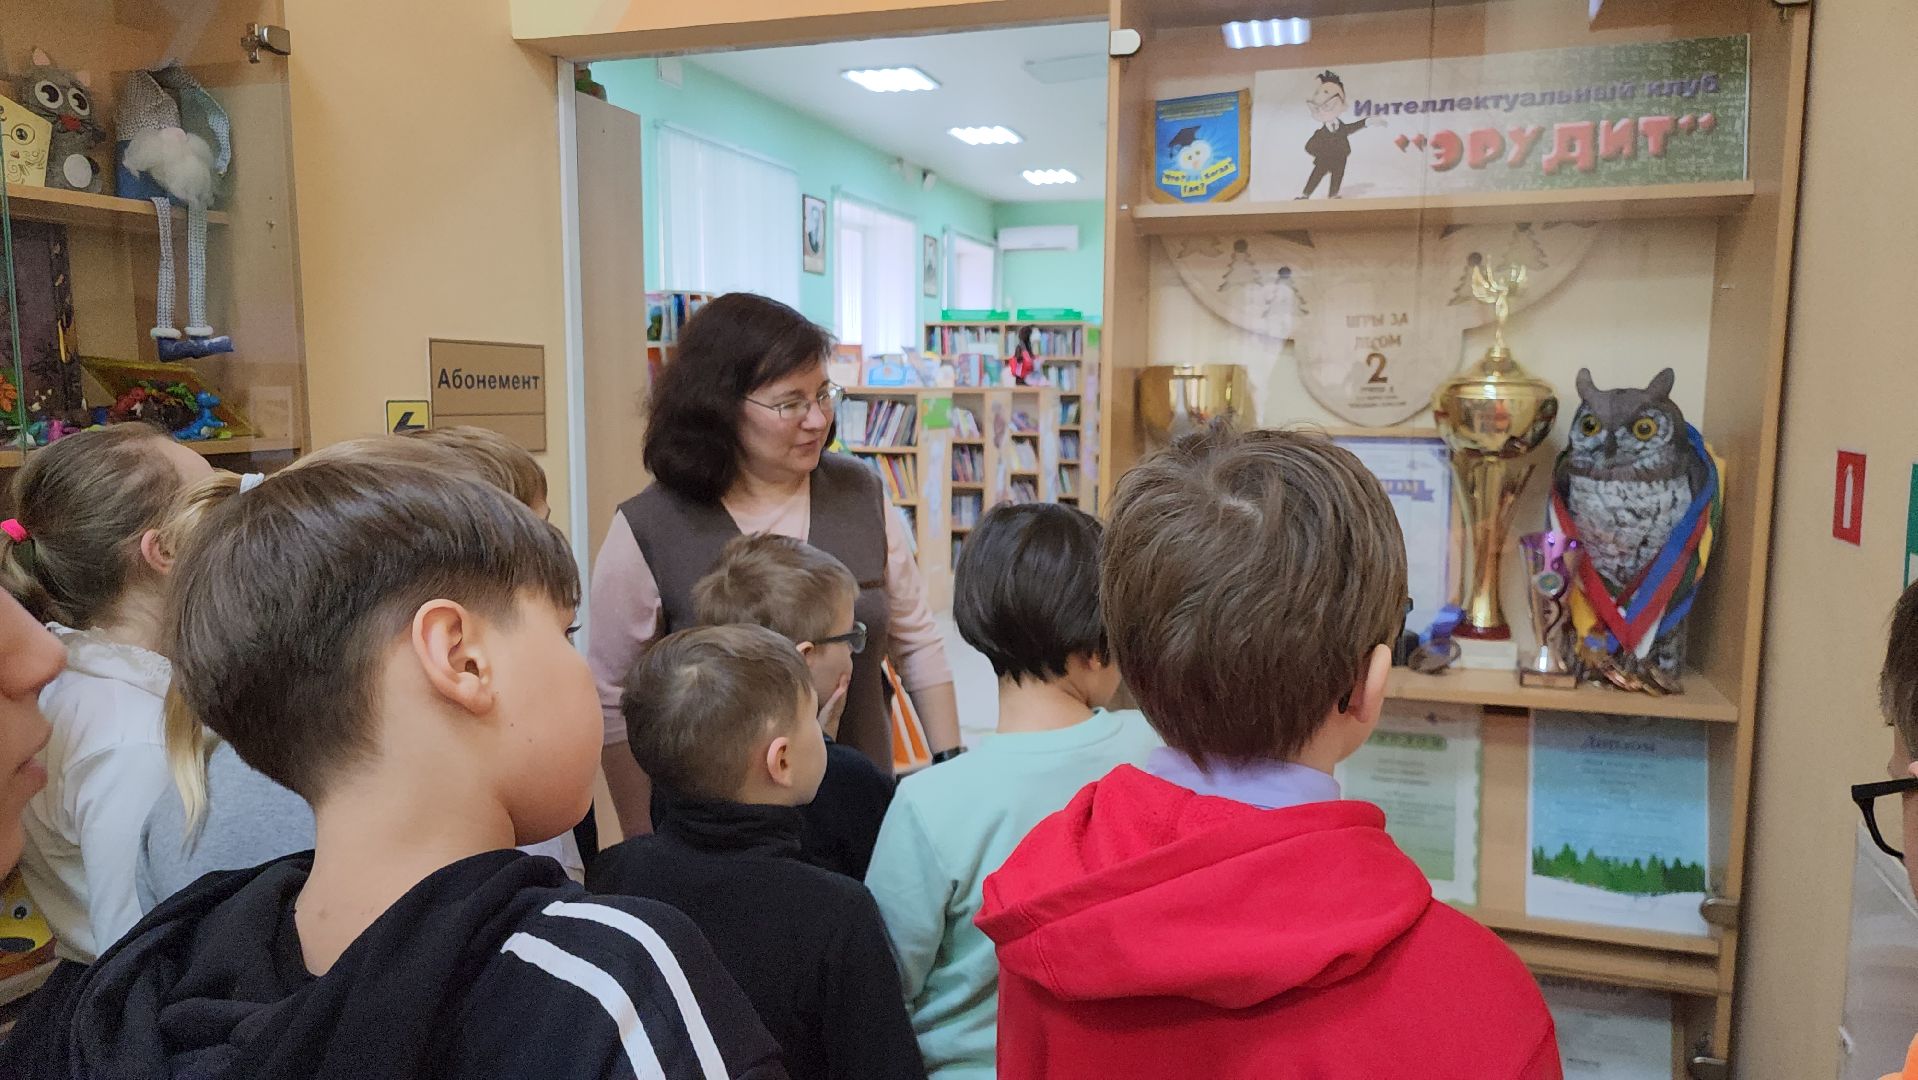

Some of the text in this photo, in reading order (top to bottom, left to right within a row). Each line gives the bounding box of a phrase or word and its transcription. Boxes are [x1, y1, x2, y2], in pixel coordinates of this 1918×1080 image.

[1354, 74, 1720, 118] Интеллектуальный клуб
[1390, 312, 1409, 326] ЗА
[437, 368, 541, 390] Абонемент
[1366, 352, 1388, 384] 2
